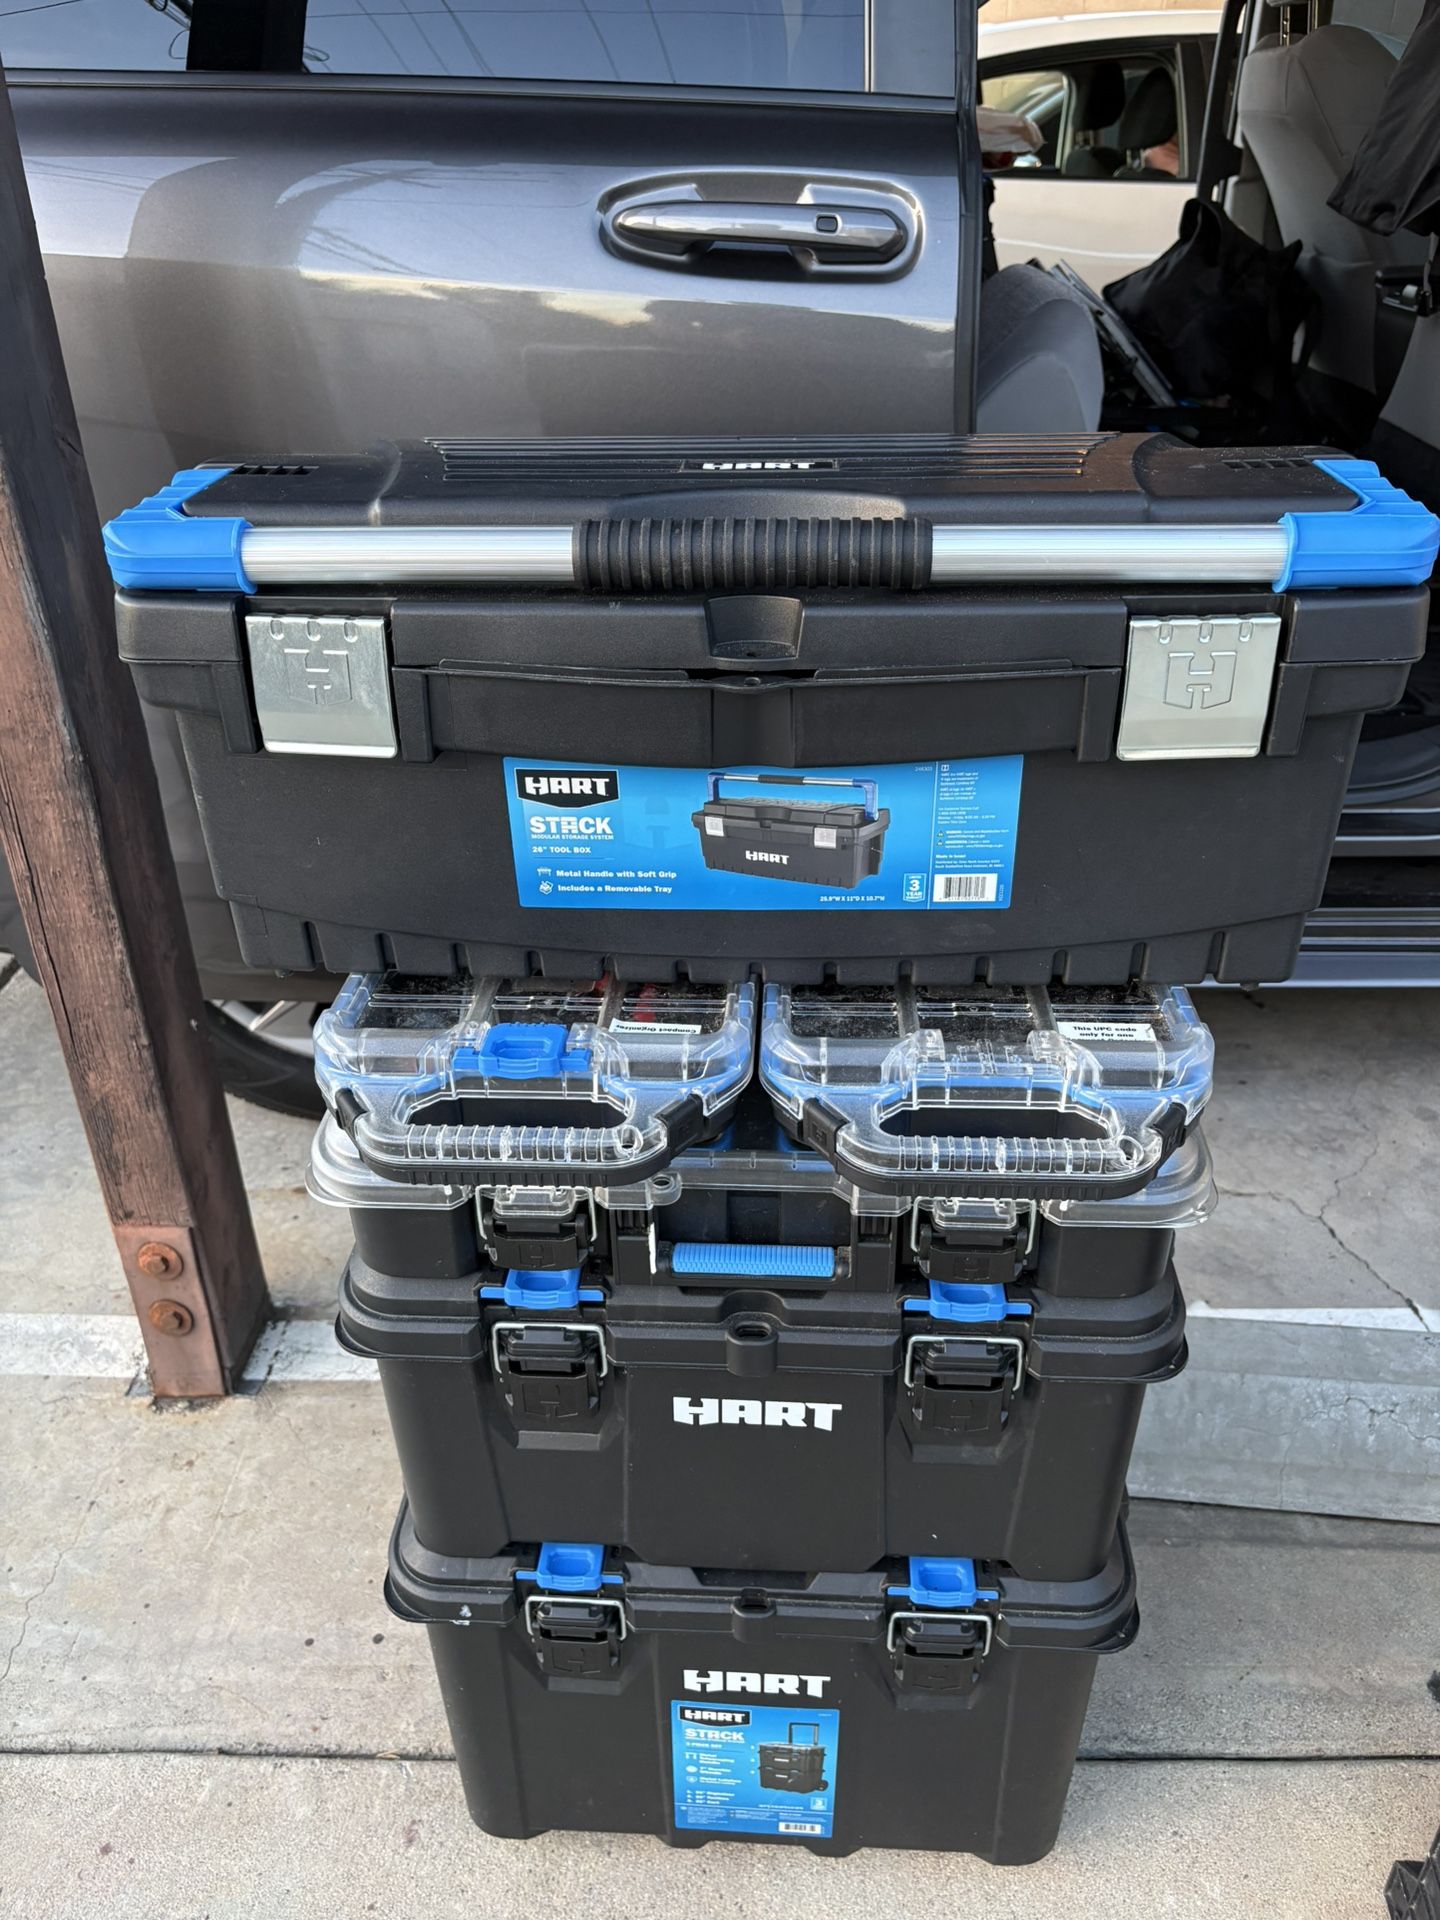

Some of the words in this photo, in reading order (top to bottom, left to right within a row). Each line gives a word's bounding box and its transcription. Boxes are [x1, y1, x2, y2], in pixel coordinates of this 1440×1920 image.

[702, 462, 816, 470] HART
[525, 777, 610, 796] HART
[530, 816, 614, 834] STACK
[532, 846, 547, 854] 26"
[745, 850, 790, 865] HART
[556, 870, 581, 878] Metal
[583, 870, 614, 878] Handle
[616, 870, 635, 878] with
[637, 870, 657, 878] Soft
[659, 871, 677, 879] Grip
[558, 885, 595, 893] Includes
[605, 885, 651, 893] Removable
[653, 886, 672, 894] Tray
[909, 880, 920, 891] 3
[616, 1024, 656, 1032] Organizer
[673, 1397, 842, 1431] HART
[683, 1669, 831, 1698] HART
[685, 1709, 745, 1723] HART
[685, 1728, 744, 1740] STACK
